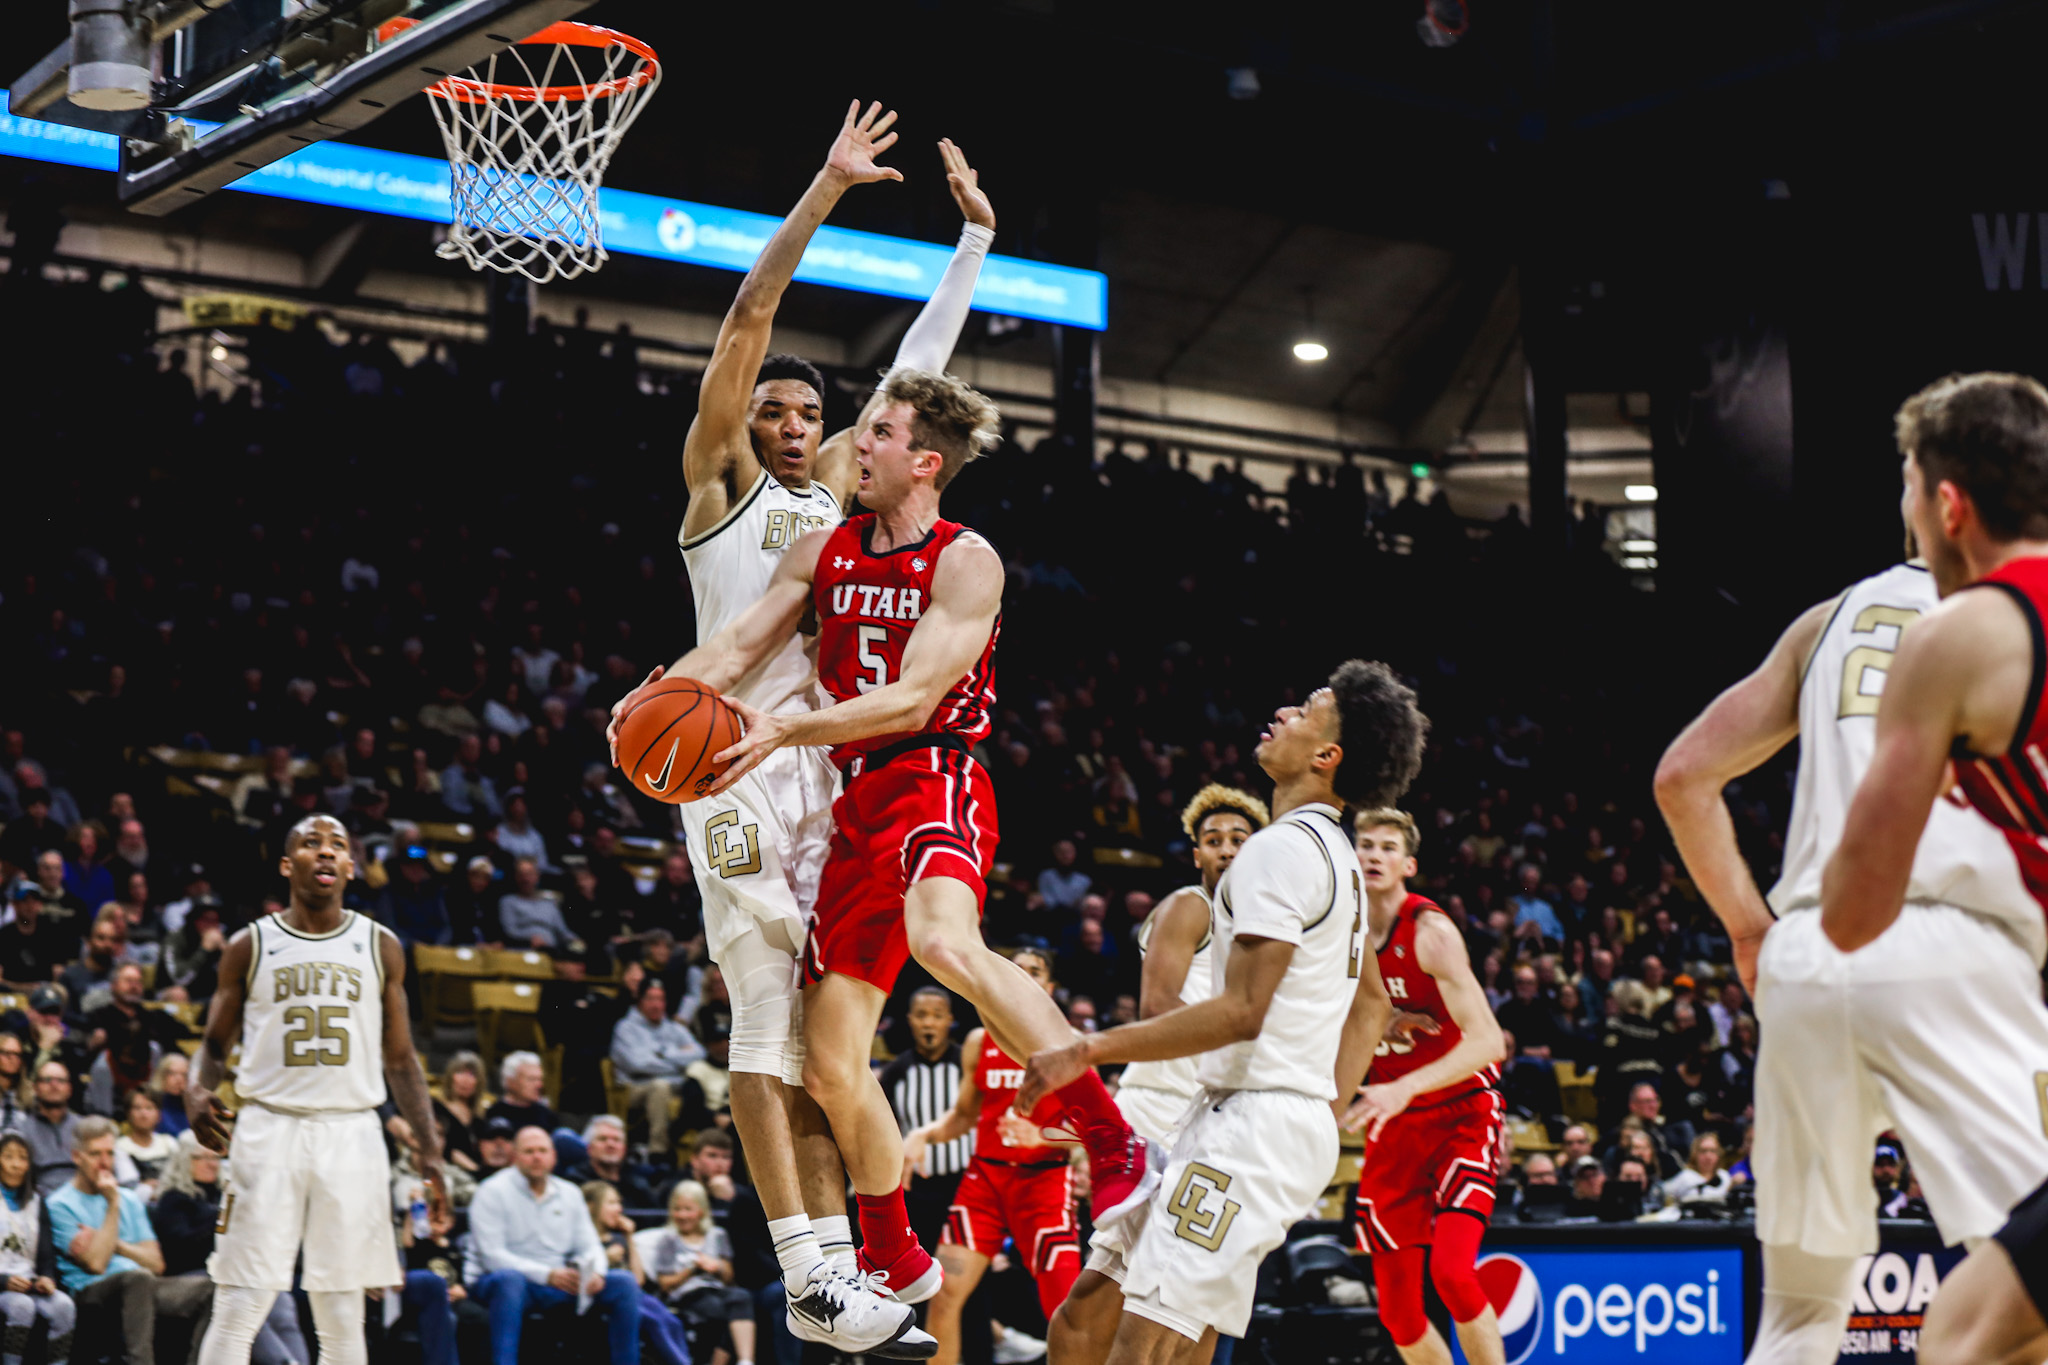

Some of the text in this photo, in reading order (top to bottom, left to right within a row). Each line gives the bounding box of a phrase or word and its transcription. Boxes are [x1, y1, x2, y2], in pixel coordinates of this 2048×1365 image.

[832, 584, 922, 620] UTAH
[856, 623, 888, 696] 5
[273, 961, 363, 1003] BUFFS
[283, 1005, 350, 1067] 25
[1554, 1268, 1720, 1355] pepsi
